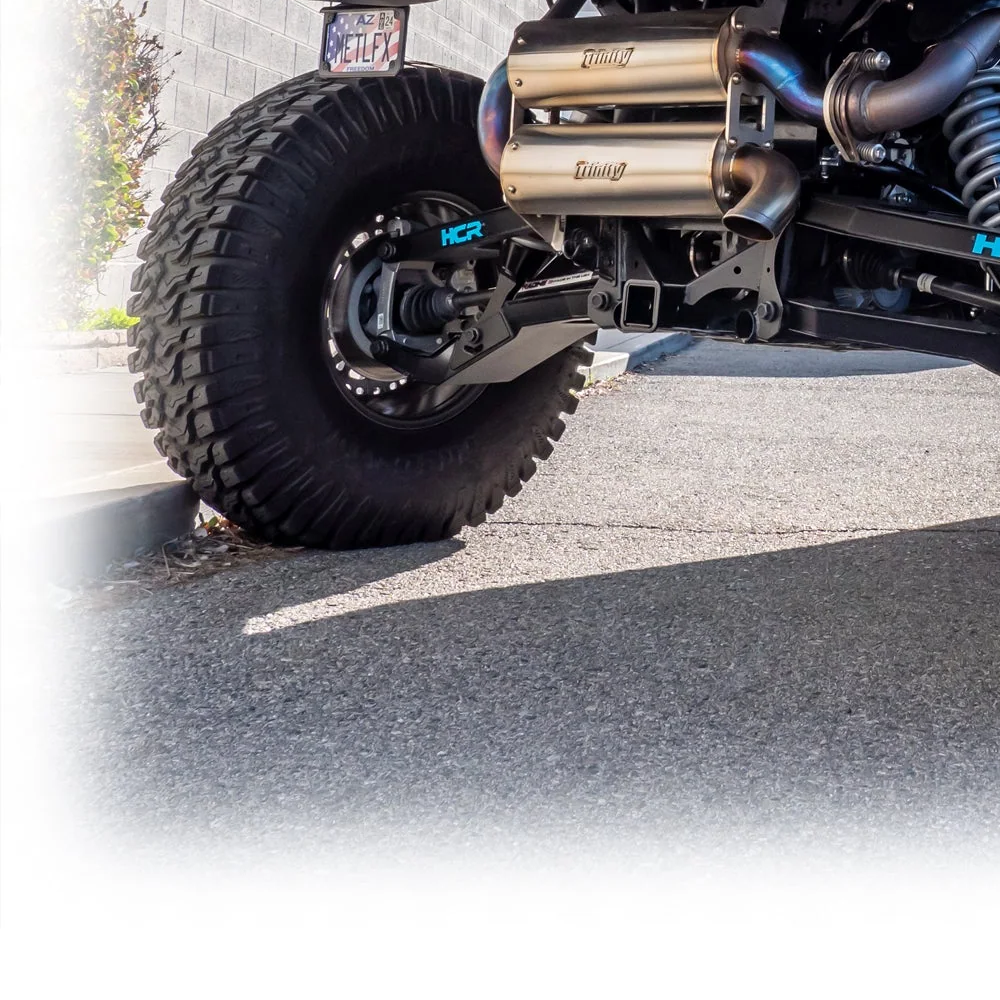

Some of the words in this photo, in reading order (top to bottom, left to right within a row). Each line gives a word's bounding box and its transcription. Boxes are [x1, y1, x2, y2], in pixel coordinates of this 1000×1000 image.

[356, 14, 375, 26] AZ
[385, 15, 394, 27] 24
[335, 32, 392, 64] METLFX
[581, 46, 635, 68] Trinity
[574, 160, 627, 181] Trinity
[440, 220, 484, 247] HCR
